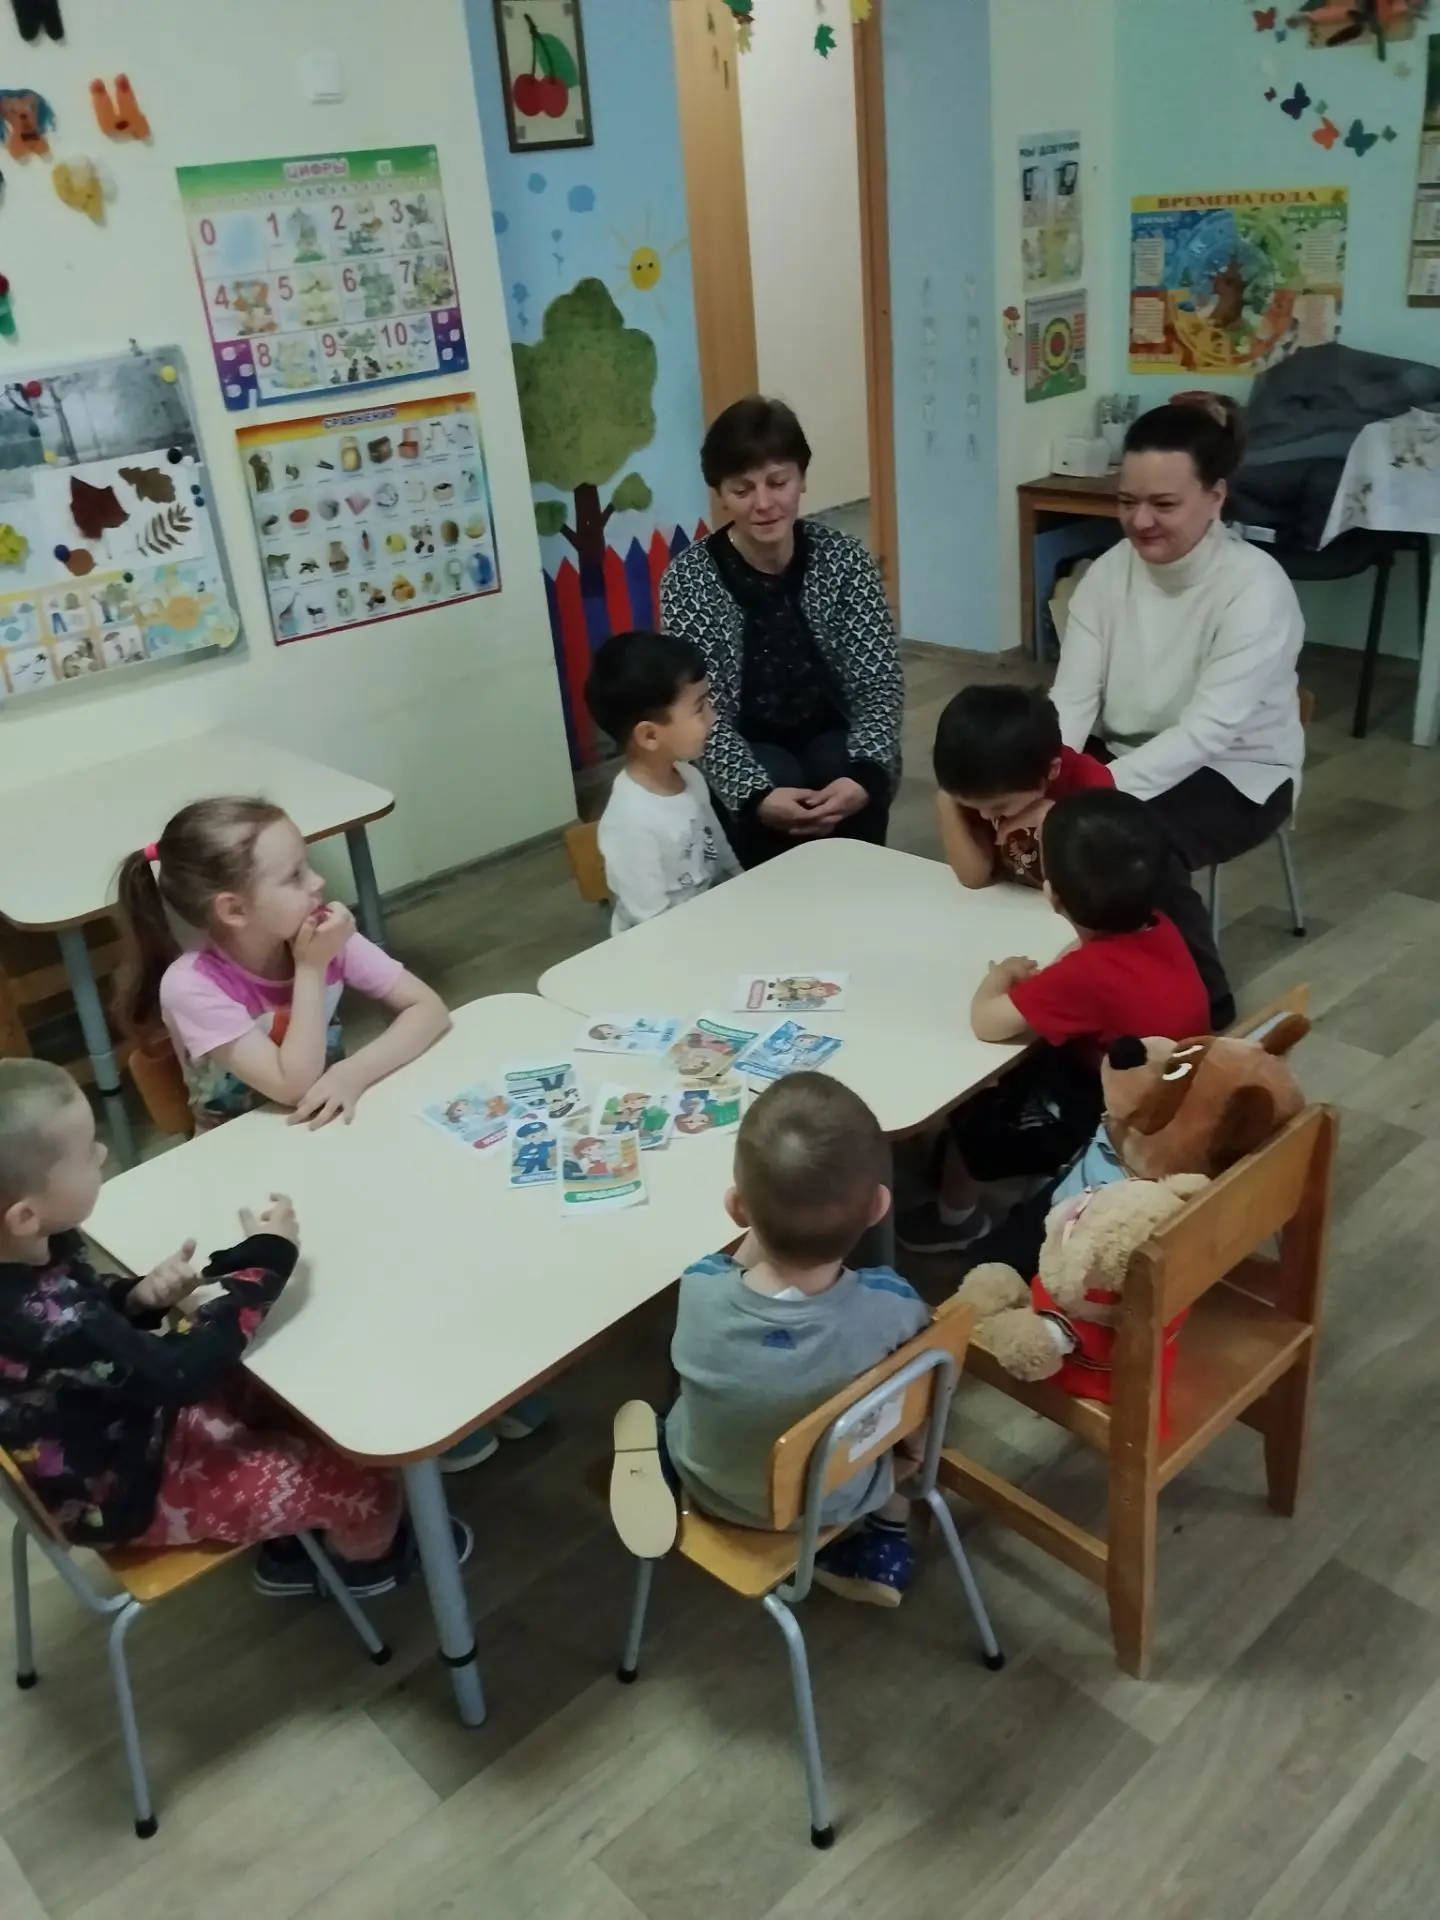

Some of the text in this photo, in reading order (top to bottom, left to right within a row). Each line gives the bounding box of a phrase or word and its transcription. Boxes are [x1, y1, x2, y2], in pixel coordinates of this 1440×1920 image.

[287, 161, 347, 179] ЦИФРЫ
[200, 199, 403, 246] 0 1 2 3
[1158, 190, 1317, 209] ВРЕМЕНА ГОДА
[214, 260, 410, 310] 4 5 6 7
[256, 321, 408, 368] 8 9 10
